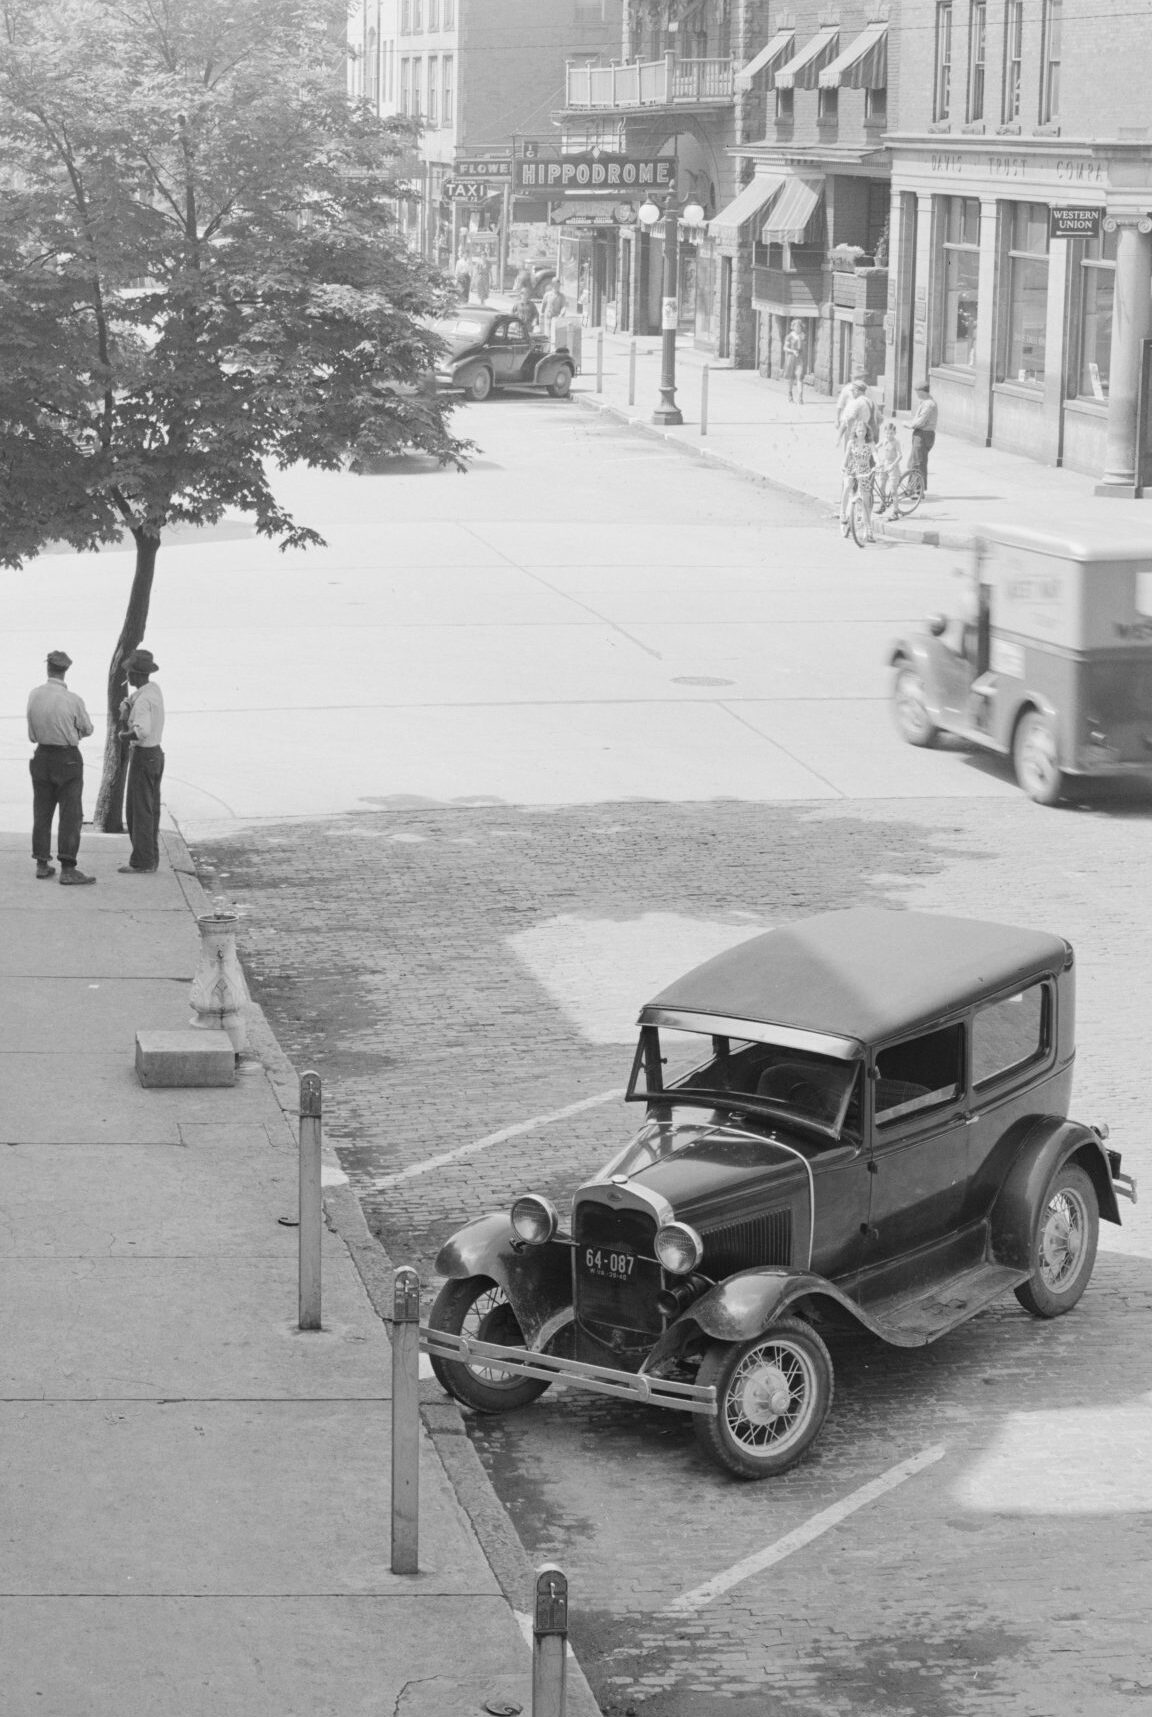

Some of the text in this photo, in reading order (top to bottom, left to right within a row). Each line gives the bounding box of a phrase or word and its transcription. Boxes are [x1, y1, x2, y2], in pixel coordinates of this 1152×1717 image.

[460, 163, 512, 174] FLOWE
[931, 154, 963, 174] DAVIS
[989, 157, 1028, 177] TRUST
[522, 163, 670, 184] HIPPODROME
[446, 184, 484, 196] TAXI
[1053, 210, 1099, 220] WESTERN
[1059, 220, 1093, 229] UNION
[586, 1248, 634, 1275] 64-087
